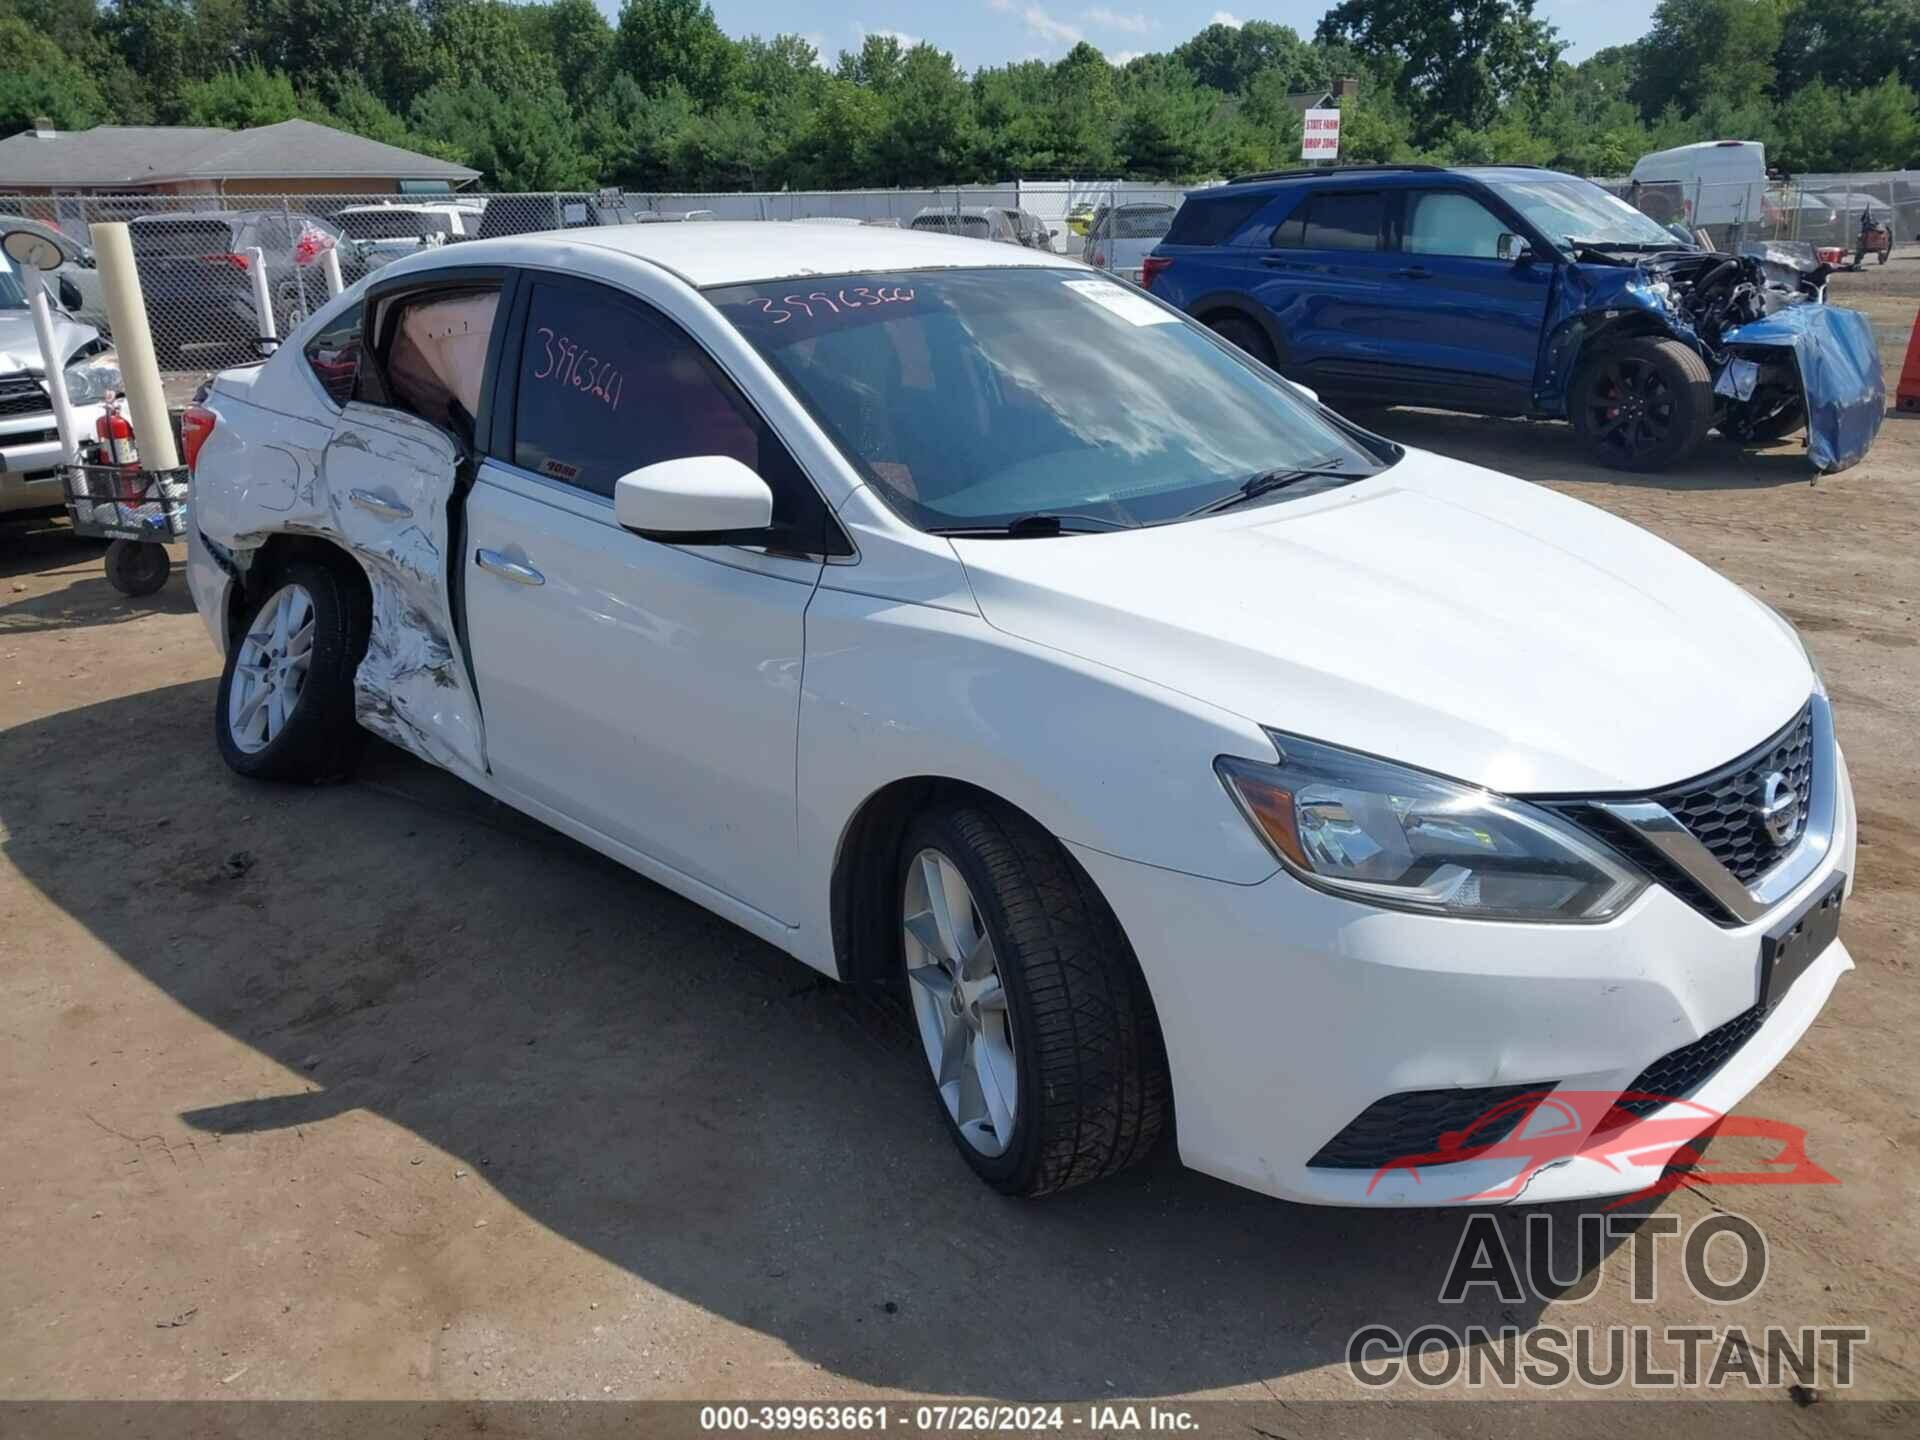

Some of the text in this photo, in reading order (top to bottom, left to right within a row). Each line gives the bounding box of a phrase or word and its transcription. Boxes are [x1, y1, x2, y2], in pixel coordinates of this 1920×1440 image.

[1306, 119, 1338, 129] STATE FARM
[1304, 138, 1337, 148] DROP ZONE
